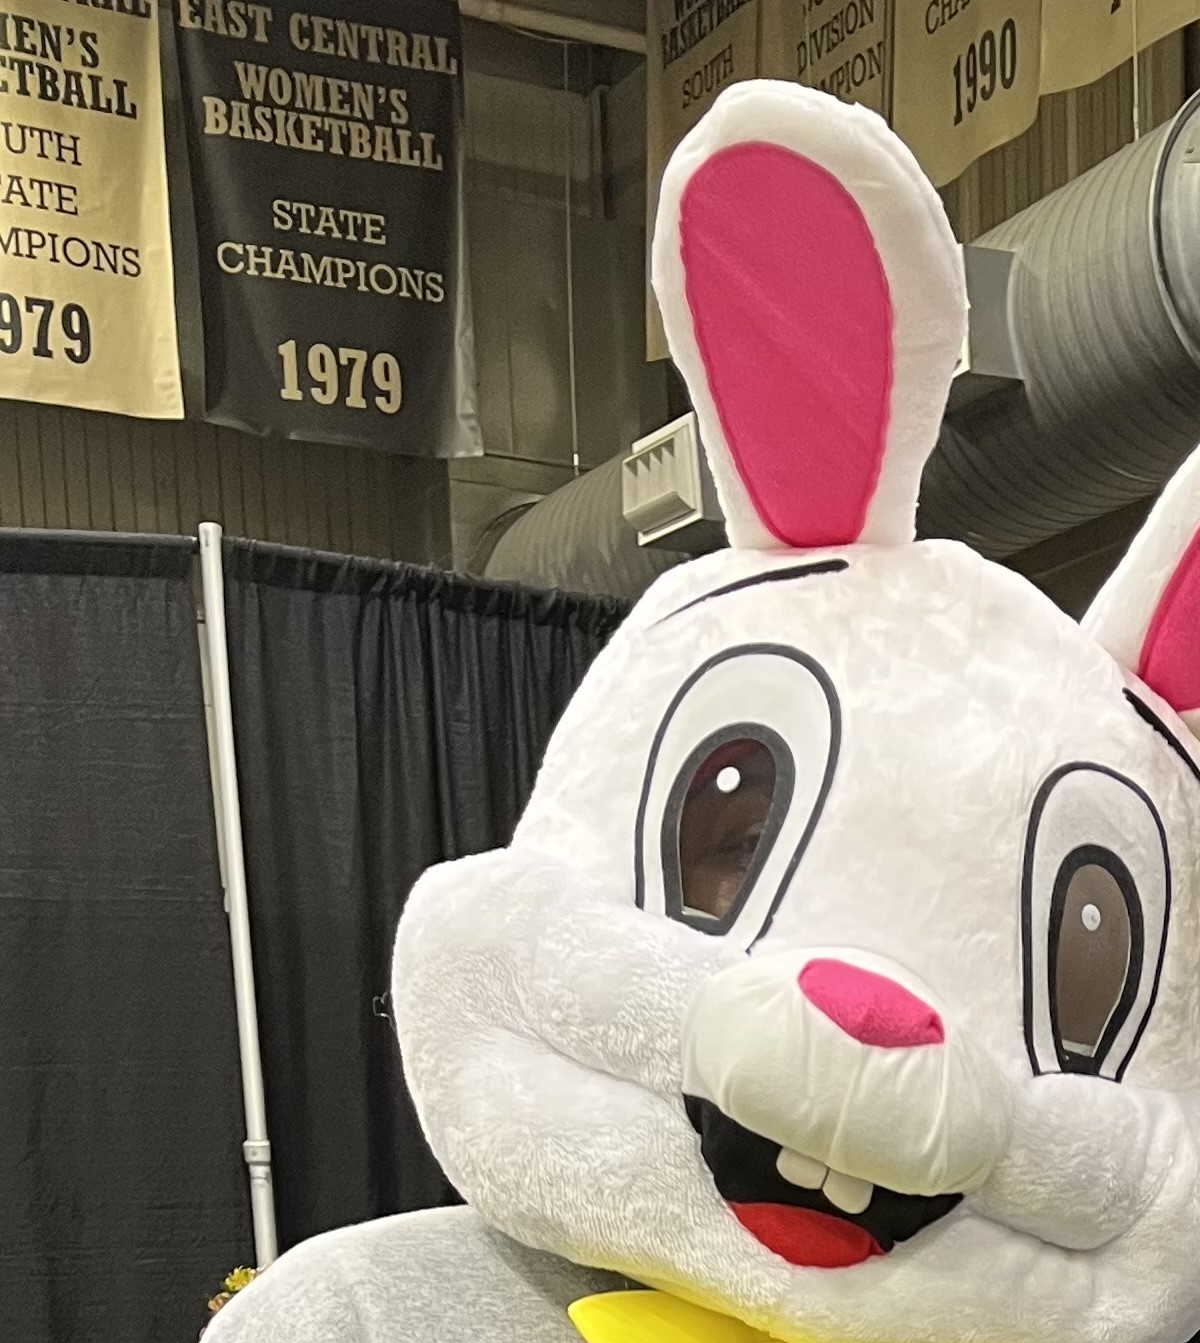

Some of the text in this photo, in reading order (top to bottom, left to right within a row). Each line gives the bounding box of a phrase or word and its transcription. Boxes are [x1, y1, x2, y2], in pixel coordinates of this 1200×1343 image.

[178, 0, 458, 75] EAST CENTRAL
[797, 0, 874, 78] DIVISION
[953, 18, 1016, 126] 1990
[233, 60, 410, 125] WOMEN'S
[682, 43, 734, 109] SOUTH
[203, 97, 443, 171] BASKETBALL
[0, 174, 78, 216] ATE
[272, 200, 386, 246] STATE
[216, 241, 445, 303] CHAMPIONS
[277, 339, 402, 414] 1979
